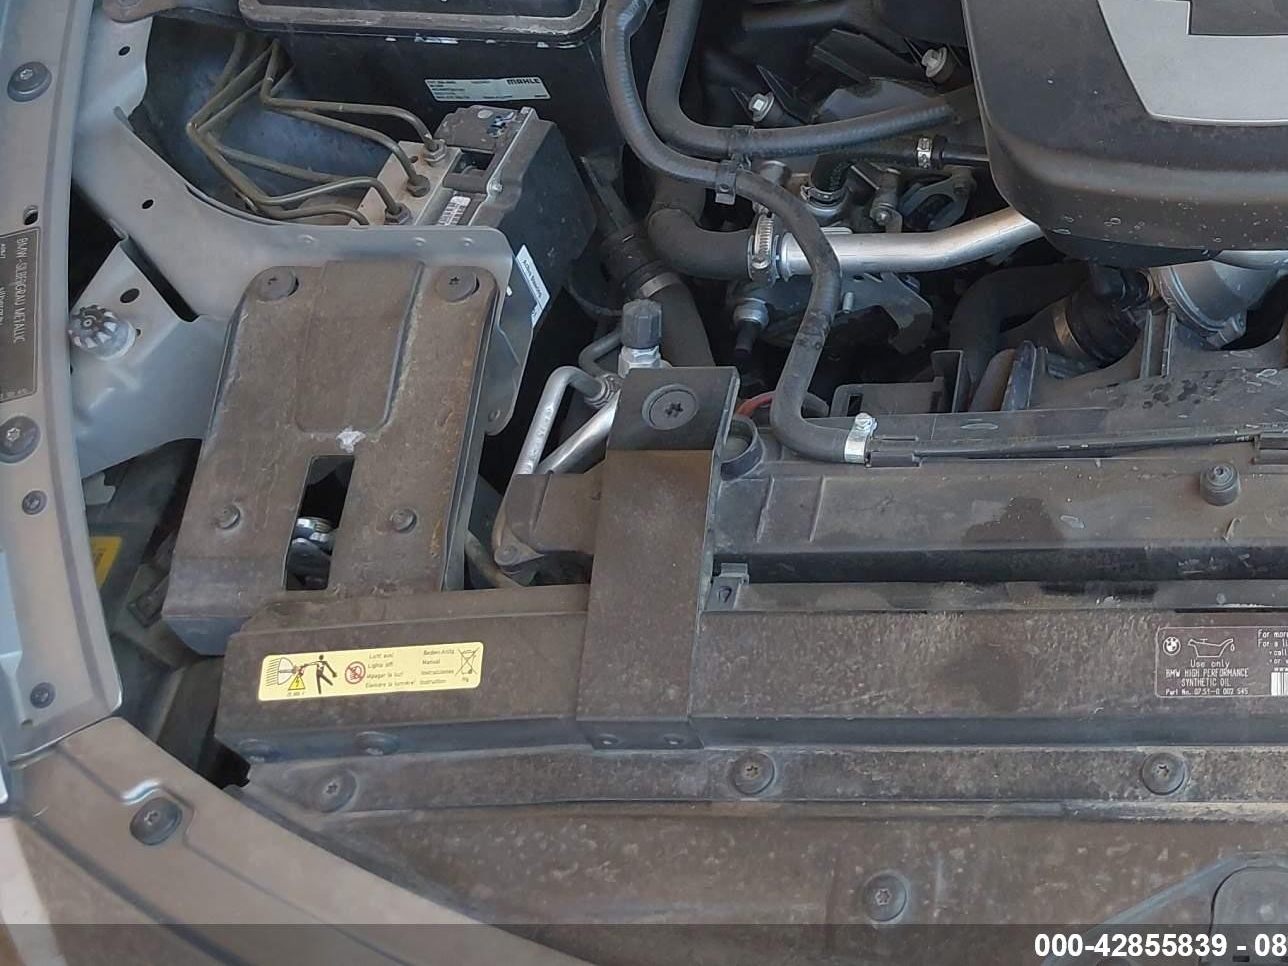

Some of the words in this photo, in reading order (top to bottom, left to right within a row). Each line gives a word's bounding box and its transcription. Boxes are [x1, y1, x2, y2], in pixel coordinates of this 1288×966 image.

[506, 78, 541, 86] MAHLE
[1257, 628, 1270, 638] For
[1257, 638, 1270, 647] For
[1273, 648, 1287, 656] call
[1190, 659, 1205, 668] Use
[1211, 659, 1230, 669] only
[1165, 668, 1181, 678] BMW
[1184, 668, 1200, 677] HIGH
[1202, 667, 1249, 677] PERFORMANCE
[1181, 678, 1217, 687] SYNTHETIC
[1220, 677, 1231, 687] OIL
[1165, 688, 1178, 696] Part
